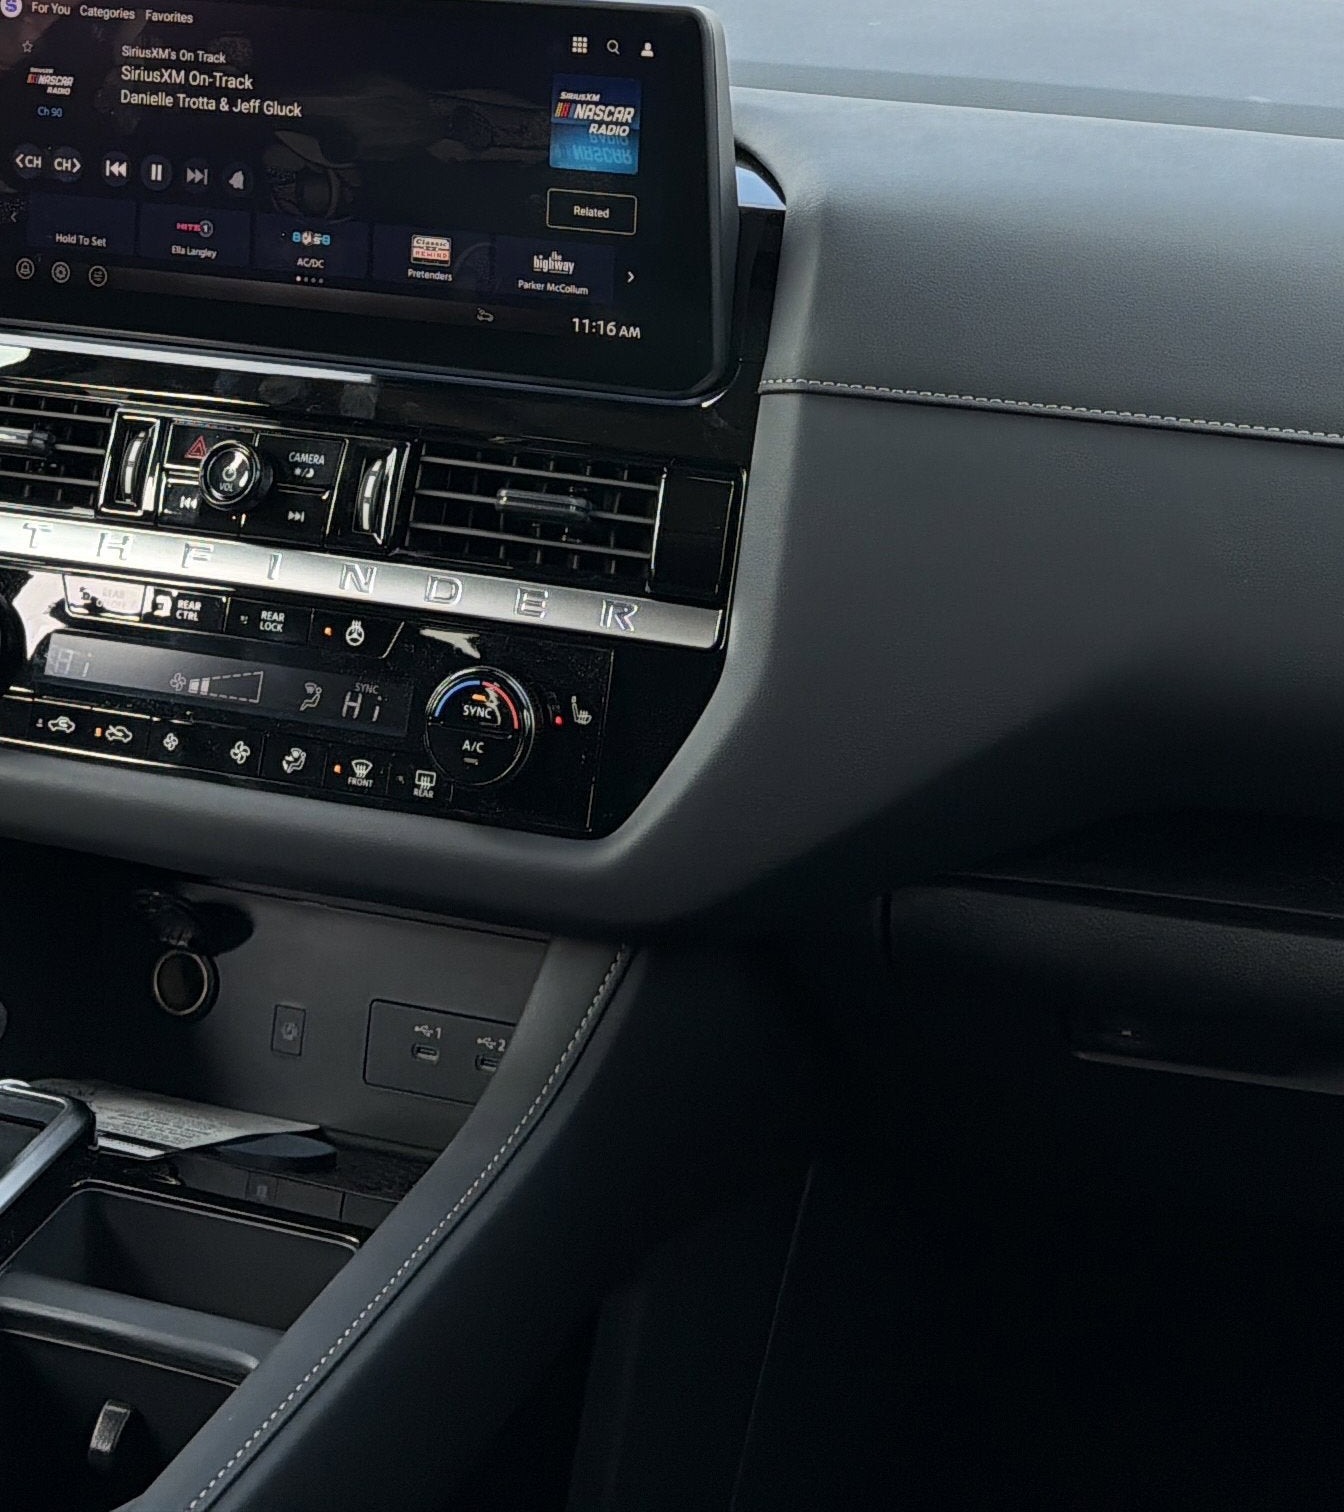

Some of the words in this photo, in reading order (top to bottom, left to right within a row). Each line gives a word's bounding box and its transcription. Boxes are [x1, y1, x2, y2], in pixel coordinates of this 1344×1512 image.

[31, 2, 48, 15] For
[50, 3, 71, 16] You
[79, 4, 136, 21] Categories
[145, 9, 194, 24] Favorites
[121, 45, 177, 61] SiriusXM's
[179, 50, 195, 62] On
[197, 50, 226, 64] Track
[38, 74, 75, 87] NASCAR
[120, 66, 186, 86] SiriusXM
[189, 70, 254, 90] On-Track
[120, 90, 174, 108] Danielle
[177, 93, 216, 111] Trotta
[219, 97, 230, 112] &
[232, 98, 260, 115] Jeff
[263, 100, 303, 118] Gluck
[37, 105, 50, 117] Ch
[51, 106, 63, 118] 90
[574, 103, 635, 123] NASCAR
[588, 123, 630, 137] RADIO
[25, 155, 42, 169] CH
[54, 157, 71, 172] CH
[573, 205, 610, 219] Related
[55, 231, 77, 245] Hold
[78, 234, 90, 246] To
[91, 235, 106, 248] Set
[414, 238, 450, 248] Classic
[171, 245, 185, 256] Ella
[186, 246, 217, 260] Langley
[415, 249, 448, 260] REWIND
[551, 251, 562, 262] the
[296, 257, 325, 269] AC/DC
[533, 254, 575, 275] highway
[408, 268, 453, 282] Pretenders
[518, 280, 545, 292] Parker
[546, 282, 588, 296] McCollum
[572, 317, 616, 337] 11:16
[619, 325, 641, 339] AM
[288, 451, 325, 466] CAMERA
[219, 481, 233, 492] VOL
[177, 599, 202, 612] REAR
[175, 609, 199, 623] CTRL
[260, 610, 285, 623] REAR
[259, 620, 284, 633] LOCK
[355, 681, 380, 695] SYNC
[462, 704, 493, 720] SYNC
[461, 740, 485, 754] A/C
[347, 775, 374, 788] FRONT
[412, 787, 435, 799] REAR
